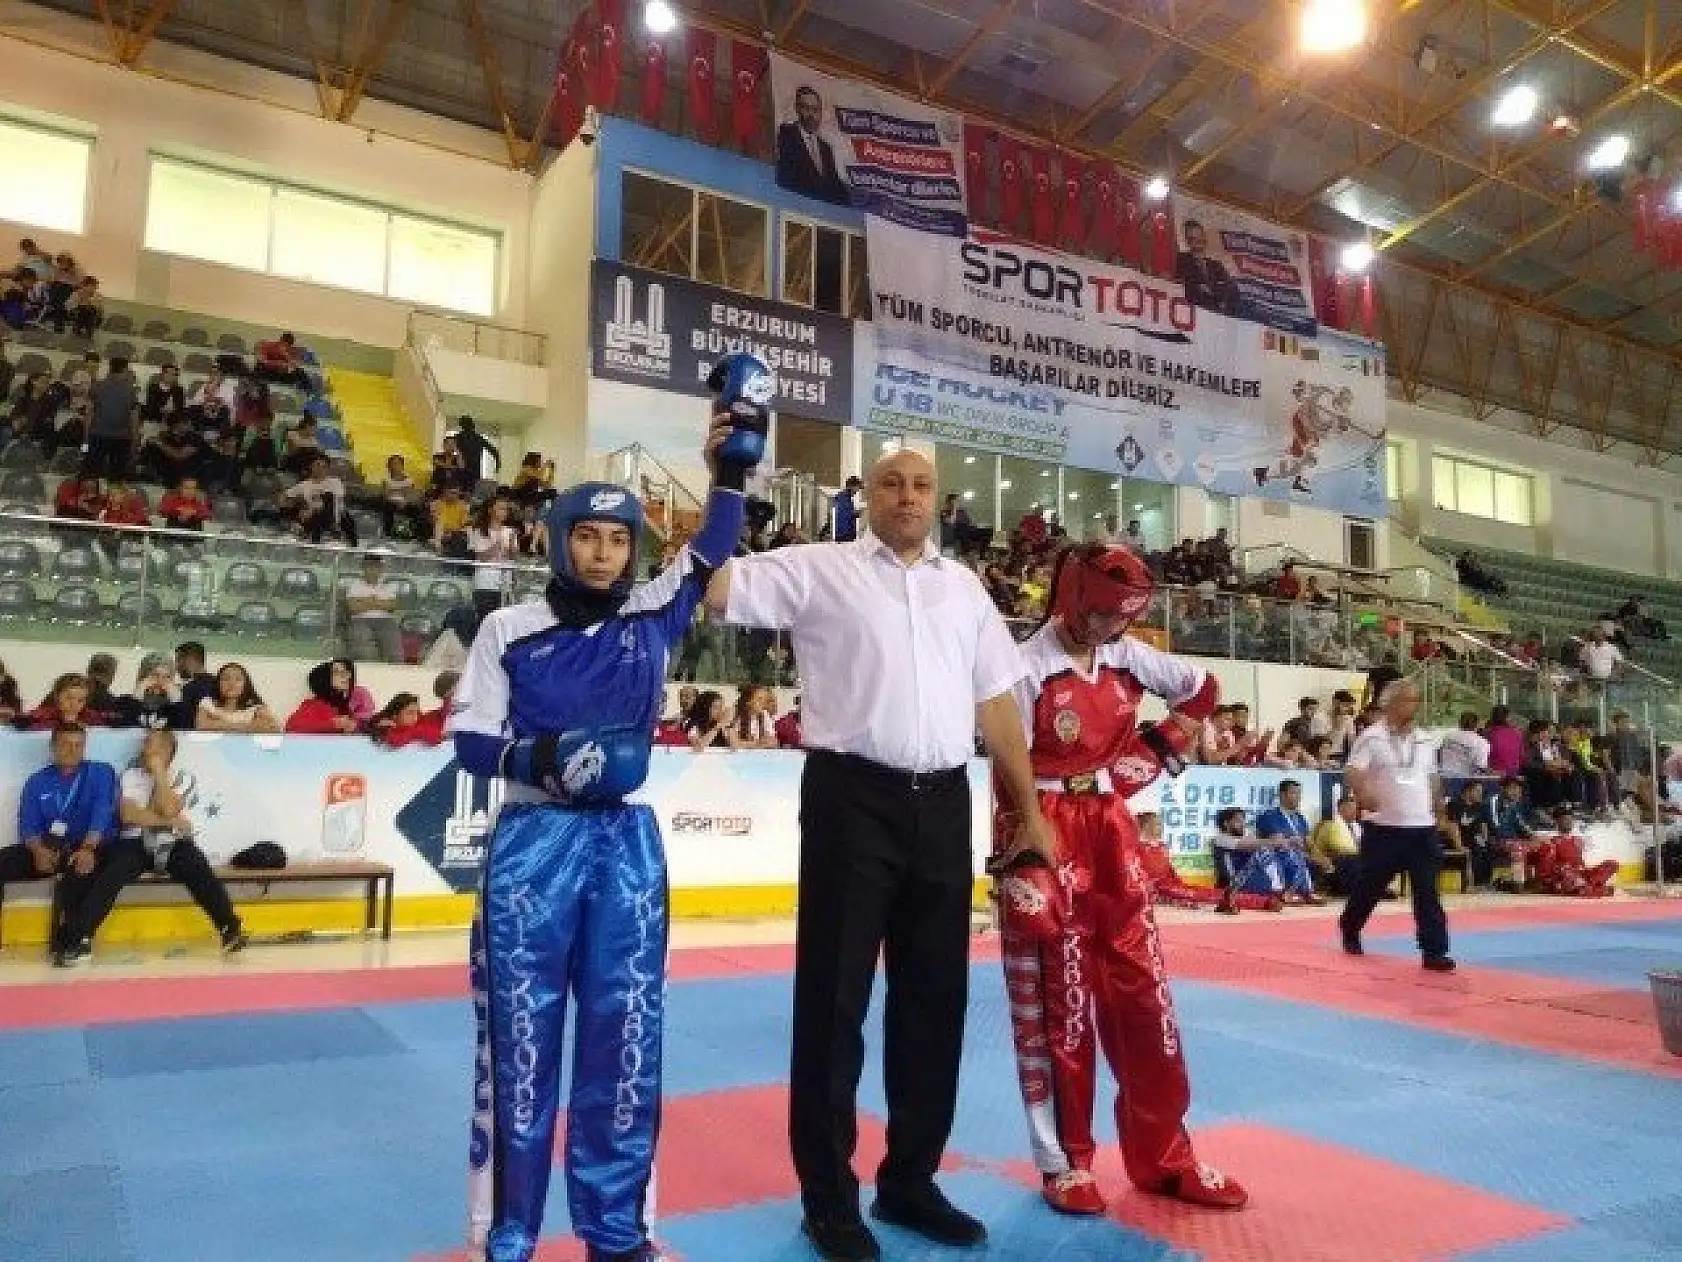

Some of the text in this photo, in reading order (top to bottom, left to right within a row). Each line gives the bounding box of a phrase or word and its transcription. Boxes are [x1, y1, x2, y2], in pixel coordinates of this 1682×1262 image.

[711, 302, 815, 345] ERZURUM
[876, 292, 923, 324] TÜM
[1024, 331, 1132, 369] ANTRENÖR
[1161, 359, 1262, 399] HAKEMLERE
[989, 354, 1100, 398] BAŞARILAR
